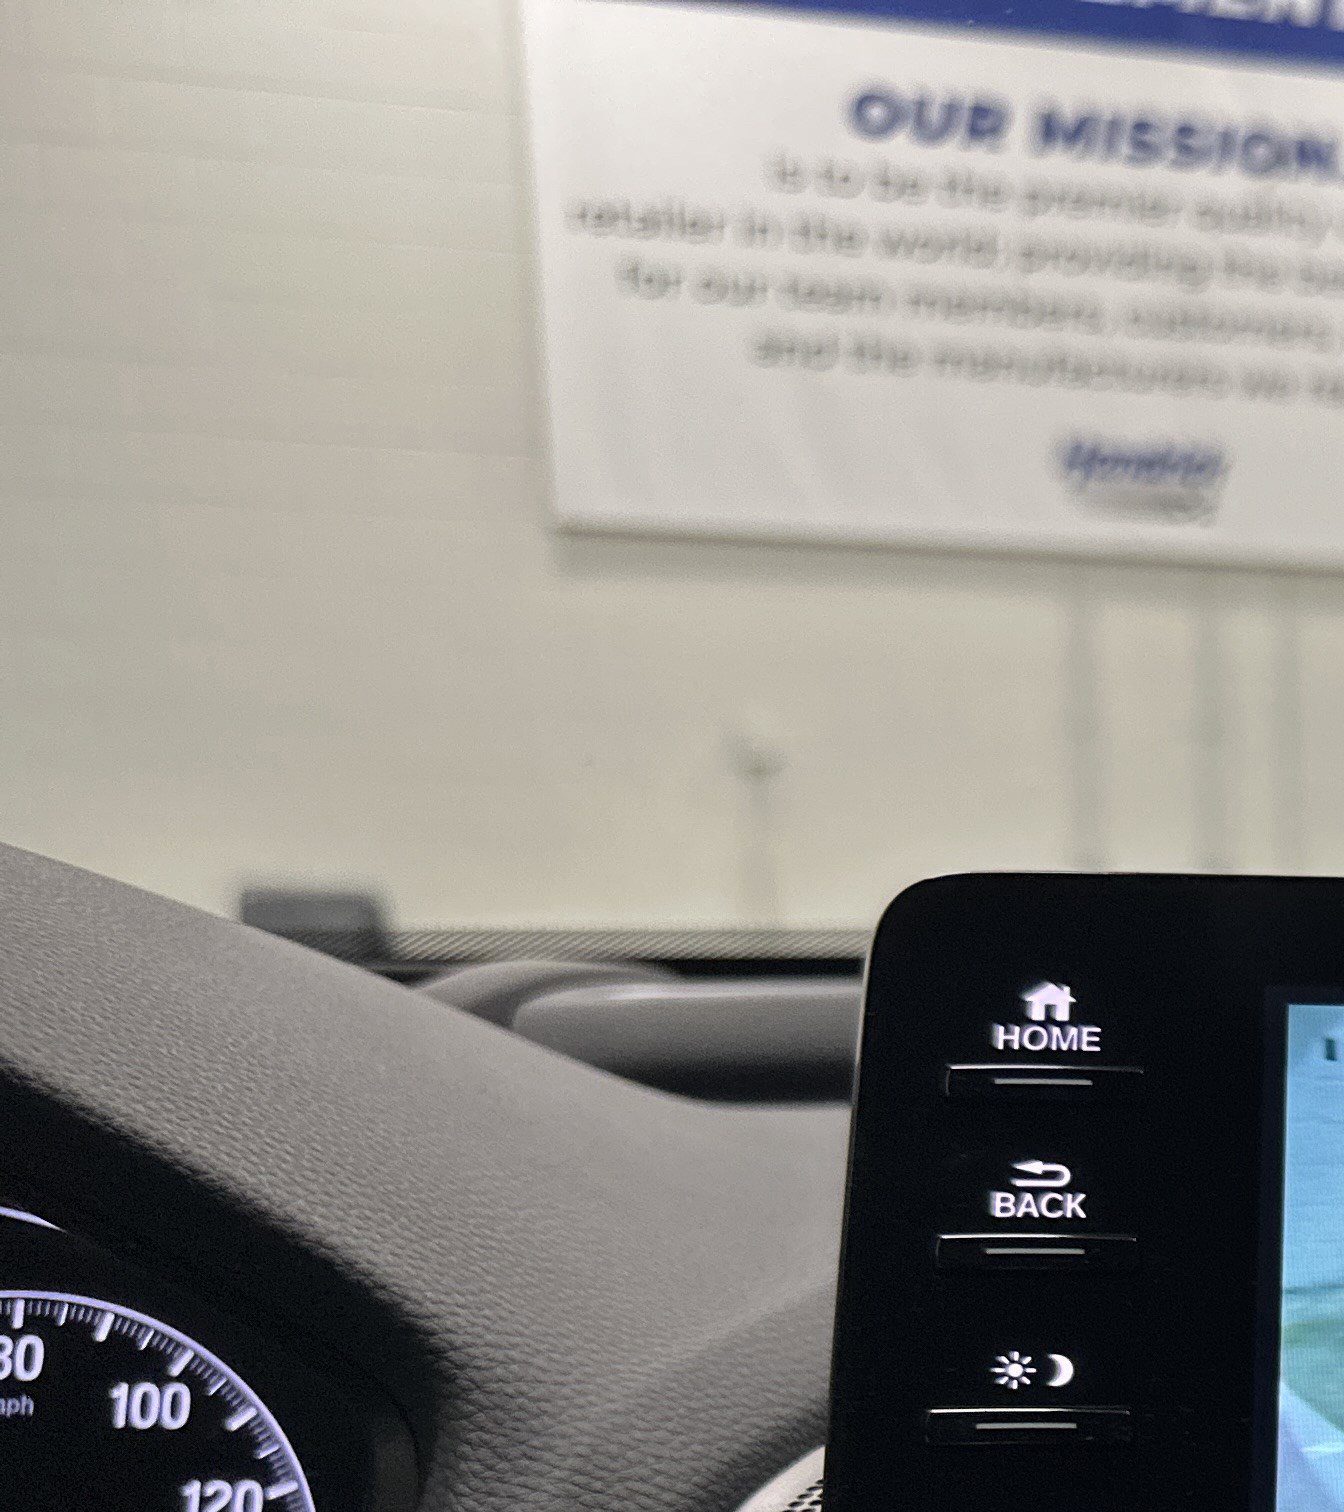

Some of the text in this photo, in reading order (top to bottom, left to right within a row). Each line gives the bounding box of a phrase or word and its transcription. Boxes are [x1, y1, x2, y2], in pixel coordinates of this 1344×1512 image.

[850, 88, 1012, 152] OUR
[992, 1023, 1102, 1052] HOME
[989, 1191, 1087, 1219] BACK
[110, 1381, 192, 1430] 100
